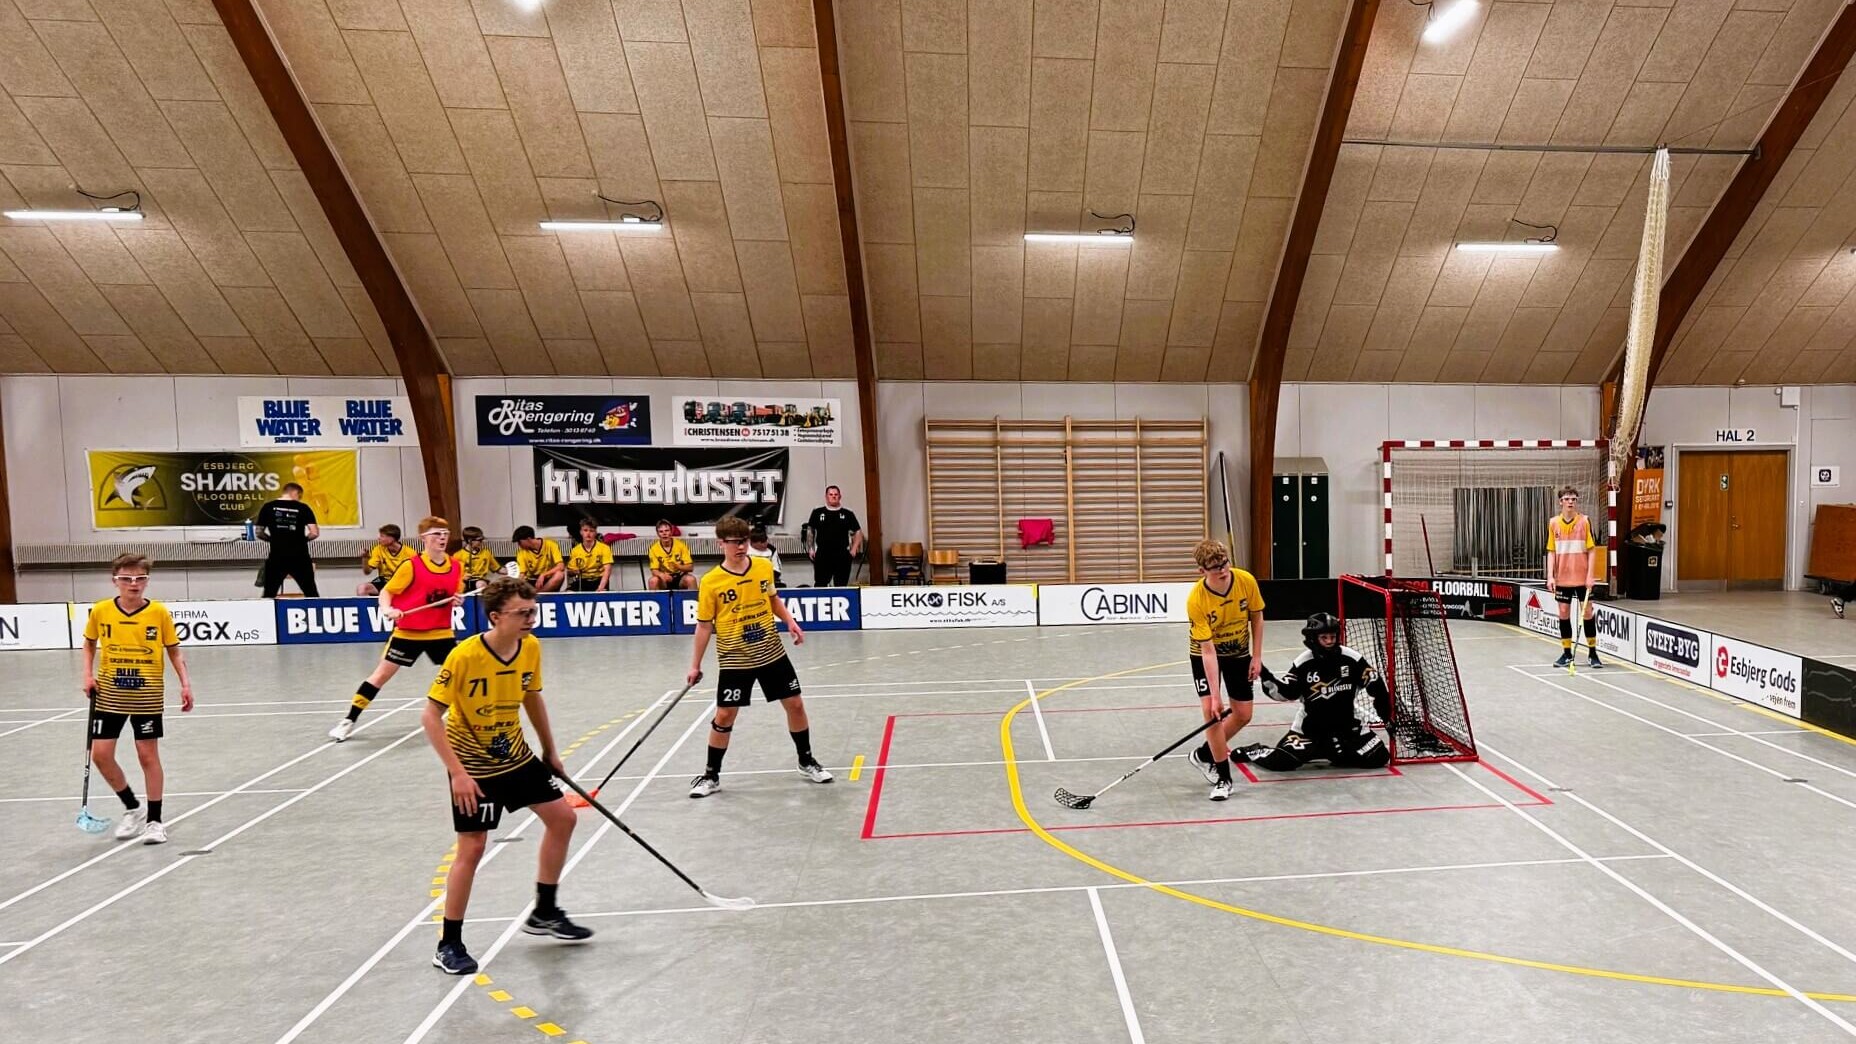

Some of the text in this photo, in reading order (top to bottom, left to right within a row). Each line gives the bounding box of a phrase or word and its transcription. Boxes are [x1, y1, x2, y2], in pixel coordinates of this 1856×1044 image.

[263, 400, 311, 418] BLUE
[346, 400, 393, 417] BLUE
[256, 418, 322, 436] WATER
[338, 418, 404, 435] WATER
[687, 428, 741, 436] CHRISTENSEN
[1716, 430, 1755, 441] HAL 2
[203, 462, 254, 470] ESBJERG
[180, 472, 281, 491] SHARKS
[541, 459, 783, 505] KLUBBHUSET
[1636, 478, 1661, 495] DYRK
[197, 493, 264, 501] FLOORBALL
[219, 503, 245, 511] CLUB
[719, 589, 737, 604] 28
[1432, 581, 1490, 598] FLOORBALL
[948, 592, 987, 607] FISK
[1081, 587, 1168, 621] CABINN
[287, 608, 359, 634] BLUE
[564, 600, 662, 628] WATER
[234, 630, 260, 641] ApS
[1647, 629, 1698, 661] STEFF-BYG
[1306, 671, 1320, 683] 66
[1730, 656, 1767, 689] Esbjerg
[1769, 668, 1796, 693] Gods
[469, 678, 487, 697] 71
[1195, 678, 1208, 692] 15
[723, 689, 741, 702] 28
[480, 803, 494, 822] 71
